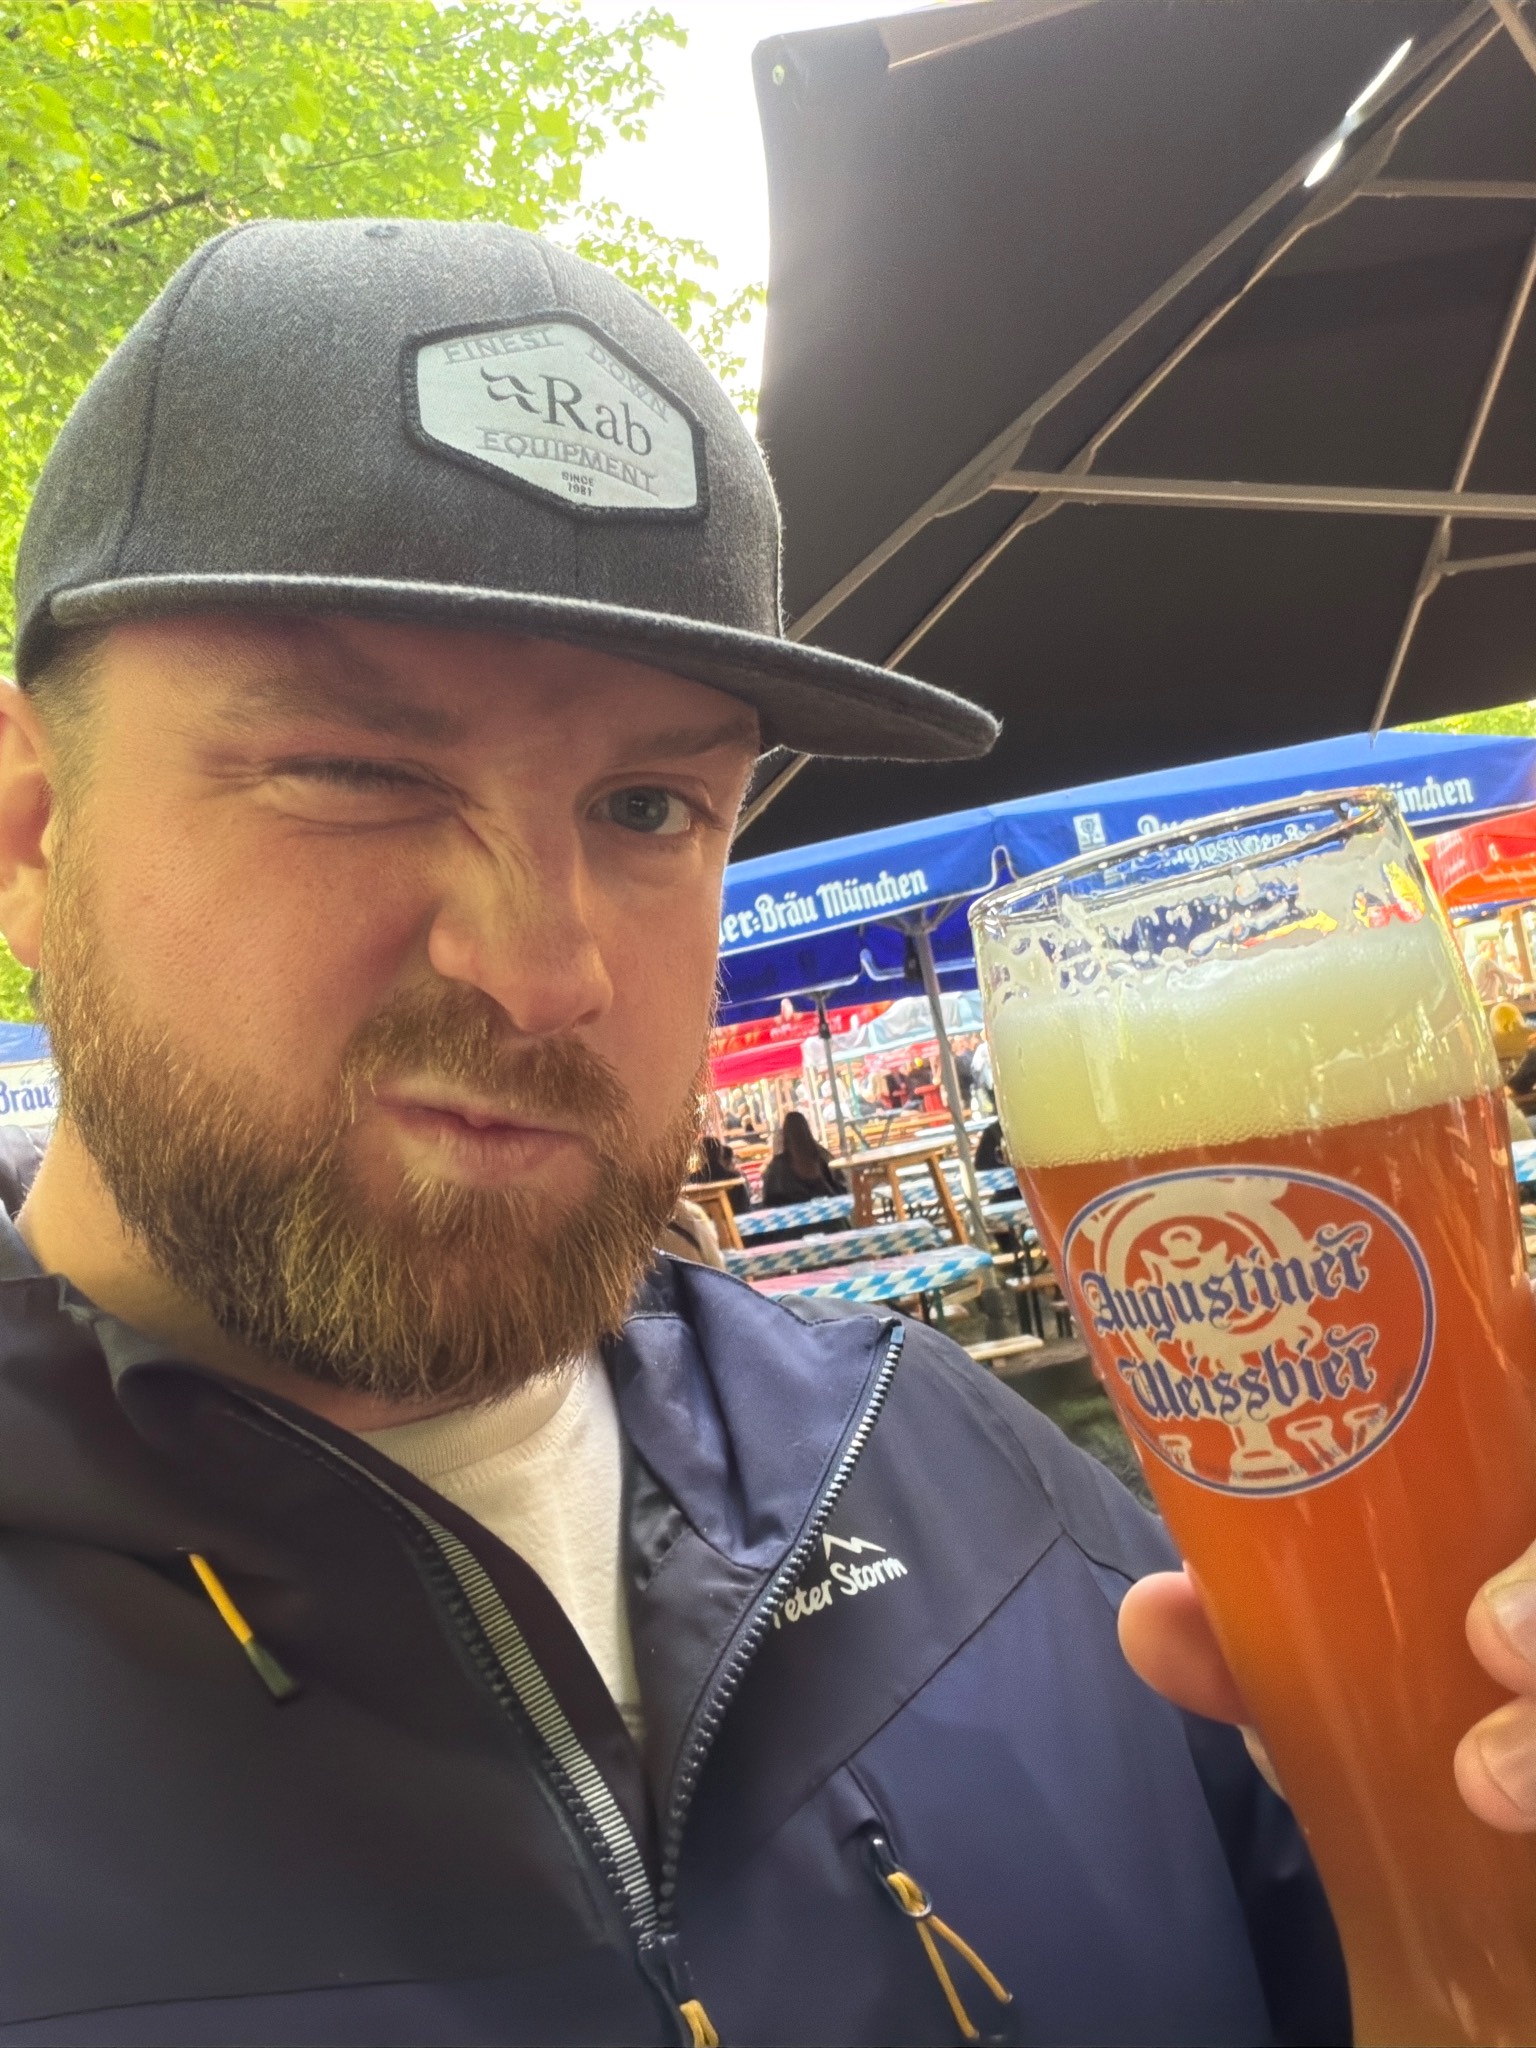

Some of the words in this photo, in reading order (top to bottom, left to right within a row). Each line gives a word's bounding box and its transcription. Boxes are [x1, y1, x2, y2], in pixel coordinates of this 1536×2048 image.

[441, 328, 564, 365] FINEST
[538, 374, 653, 457] Rab
[476, 427, 659, 497] EQUIPMENT
[561, 471, 594, 488] SINCE
[568, 482, 592, 497] 1981
[1381, 776, 1475, 814] ünchen
[816, 870, 929, 919] München
[1080, 1221, 1372, 1342] Augustiner
[1117, 1325, 1378, 1424] Weissbier
[829, 1557, 909, 1596] Storm
